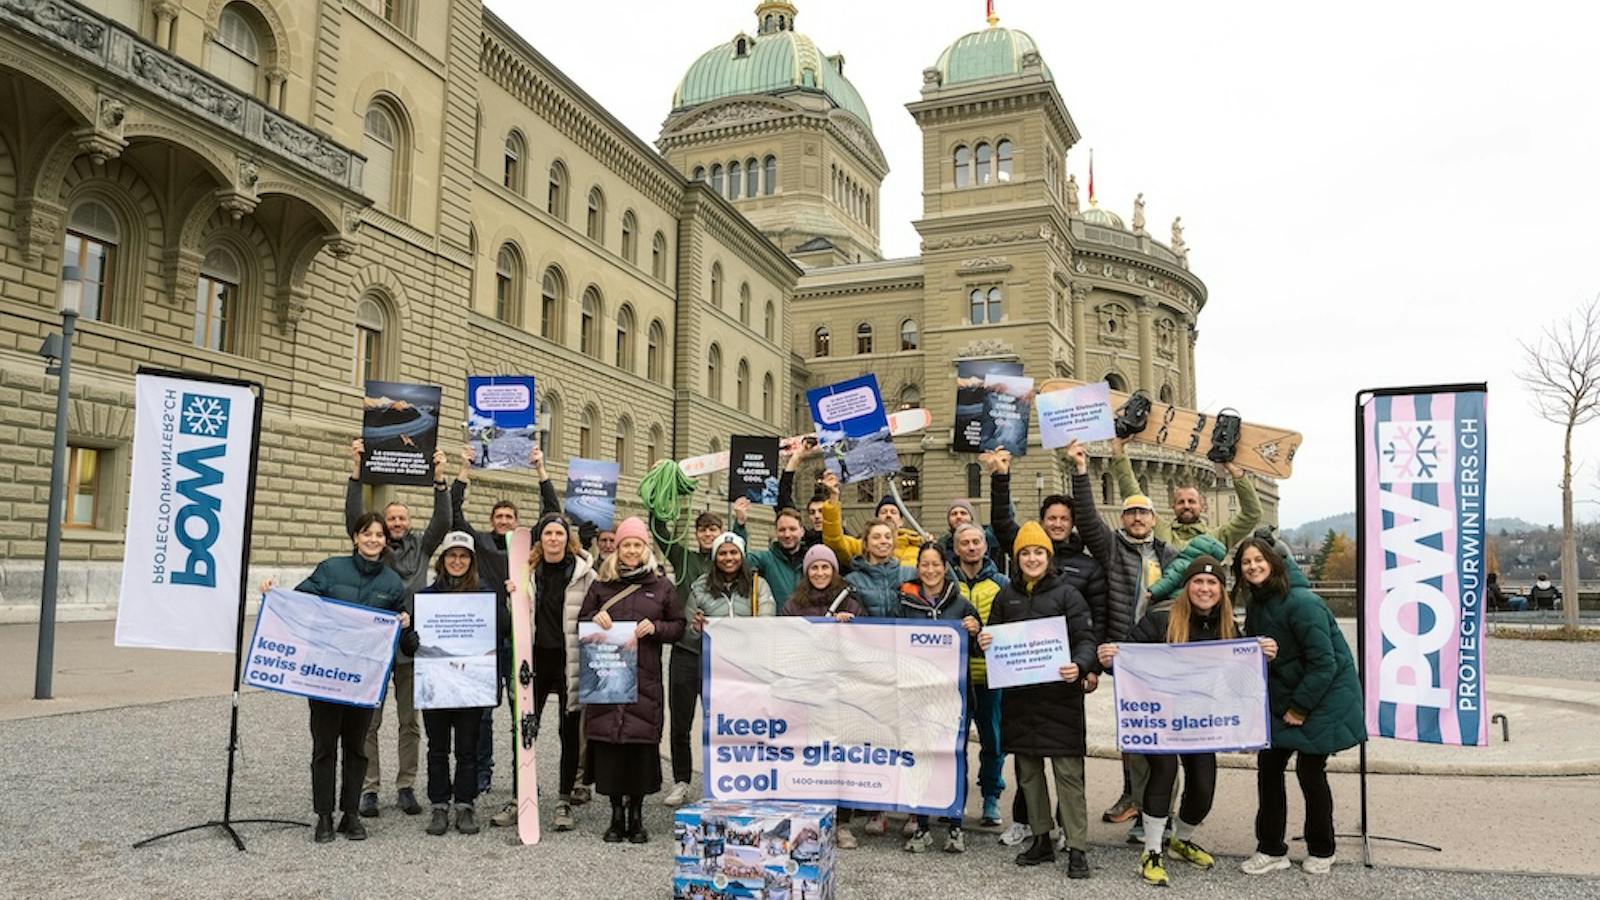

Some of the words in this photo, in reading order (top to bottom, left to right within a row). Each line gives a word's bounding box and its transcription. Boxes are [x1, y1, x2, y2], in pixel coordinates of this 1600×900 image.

[736, 467, 770, 476] GLACIERS
[1459, 418, 1480, 711] PROTECTOURWINTERS.CH
[1379, 486, 1456, 709] POW
[258, 636, 297, 657] keep
[911, 633, 942, 644] POW
[250, 670, 285, 685] cool
[253, 653, 297, 672] swiss
[300, 664, 362, 684] glaciers
[1120, 699, 1161, 714] keep
[717, 713, 788, 739] keep
[1121, 715, 1167, 728] swiss
[1171, 714, 1240, 731] glaciers
[1121, 733, 1158, 745] cool
[717, 741, 795, 763] swiss
[802, 741, 916, 767] glaciers
[717, 769, 778, 793] cool
[791, 777, 883, 789] 1400-reasons-to-act.ch
